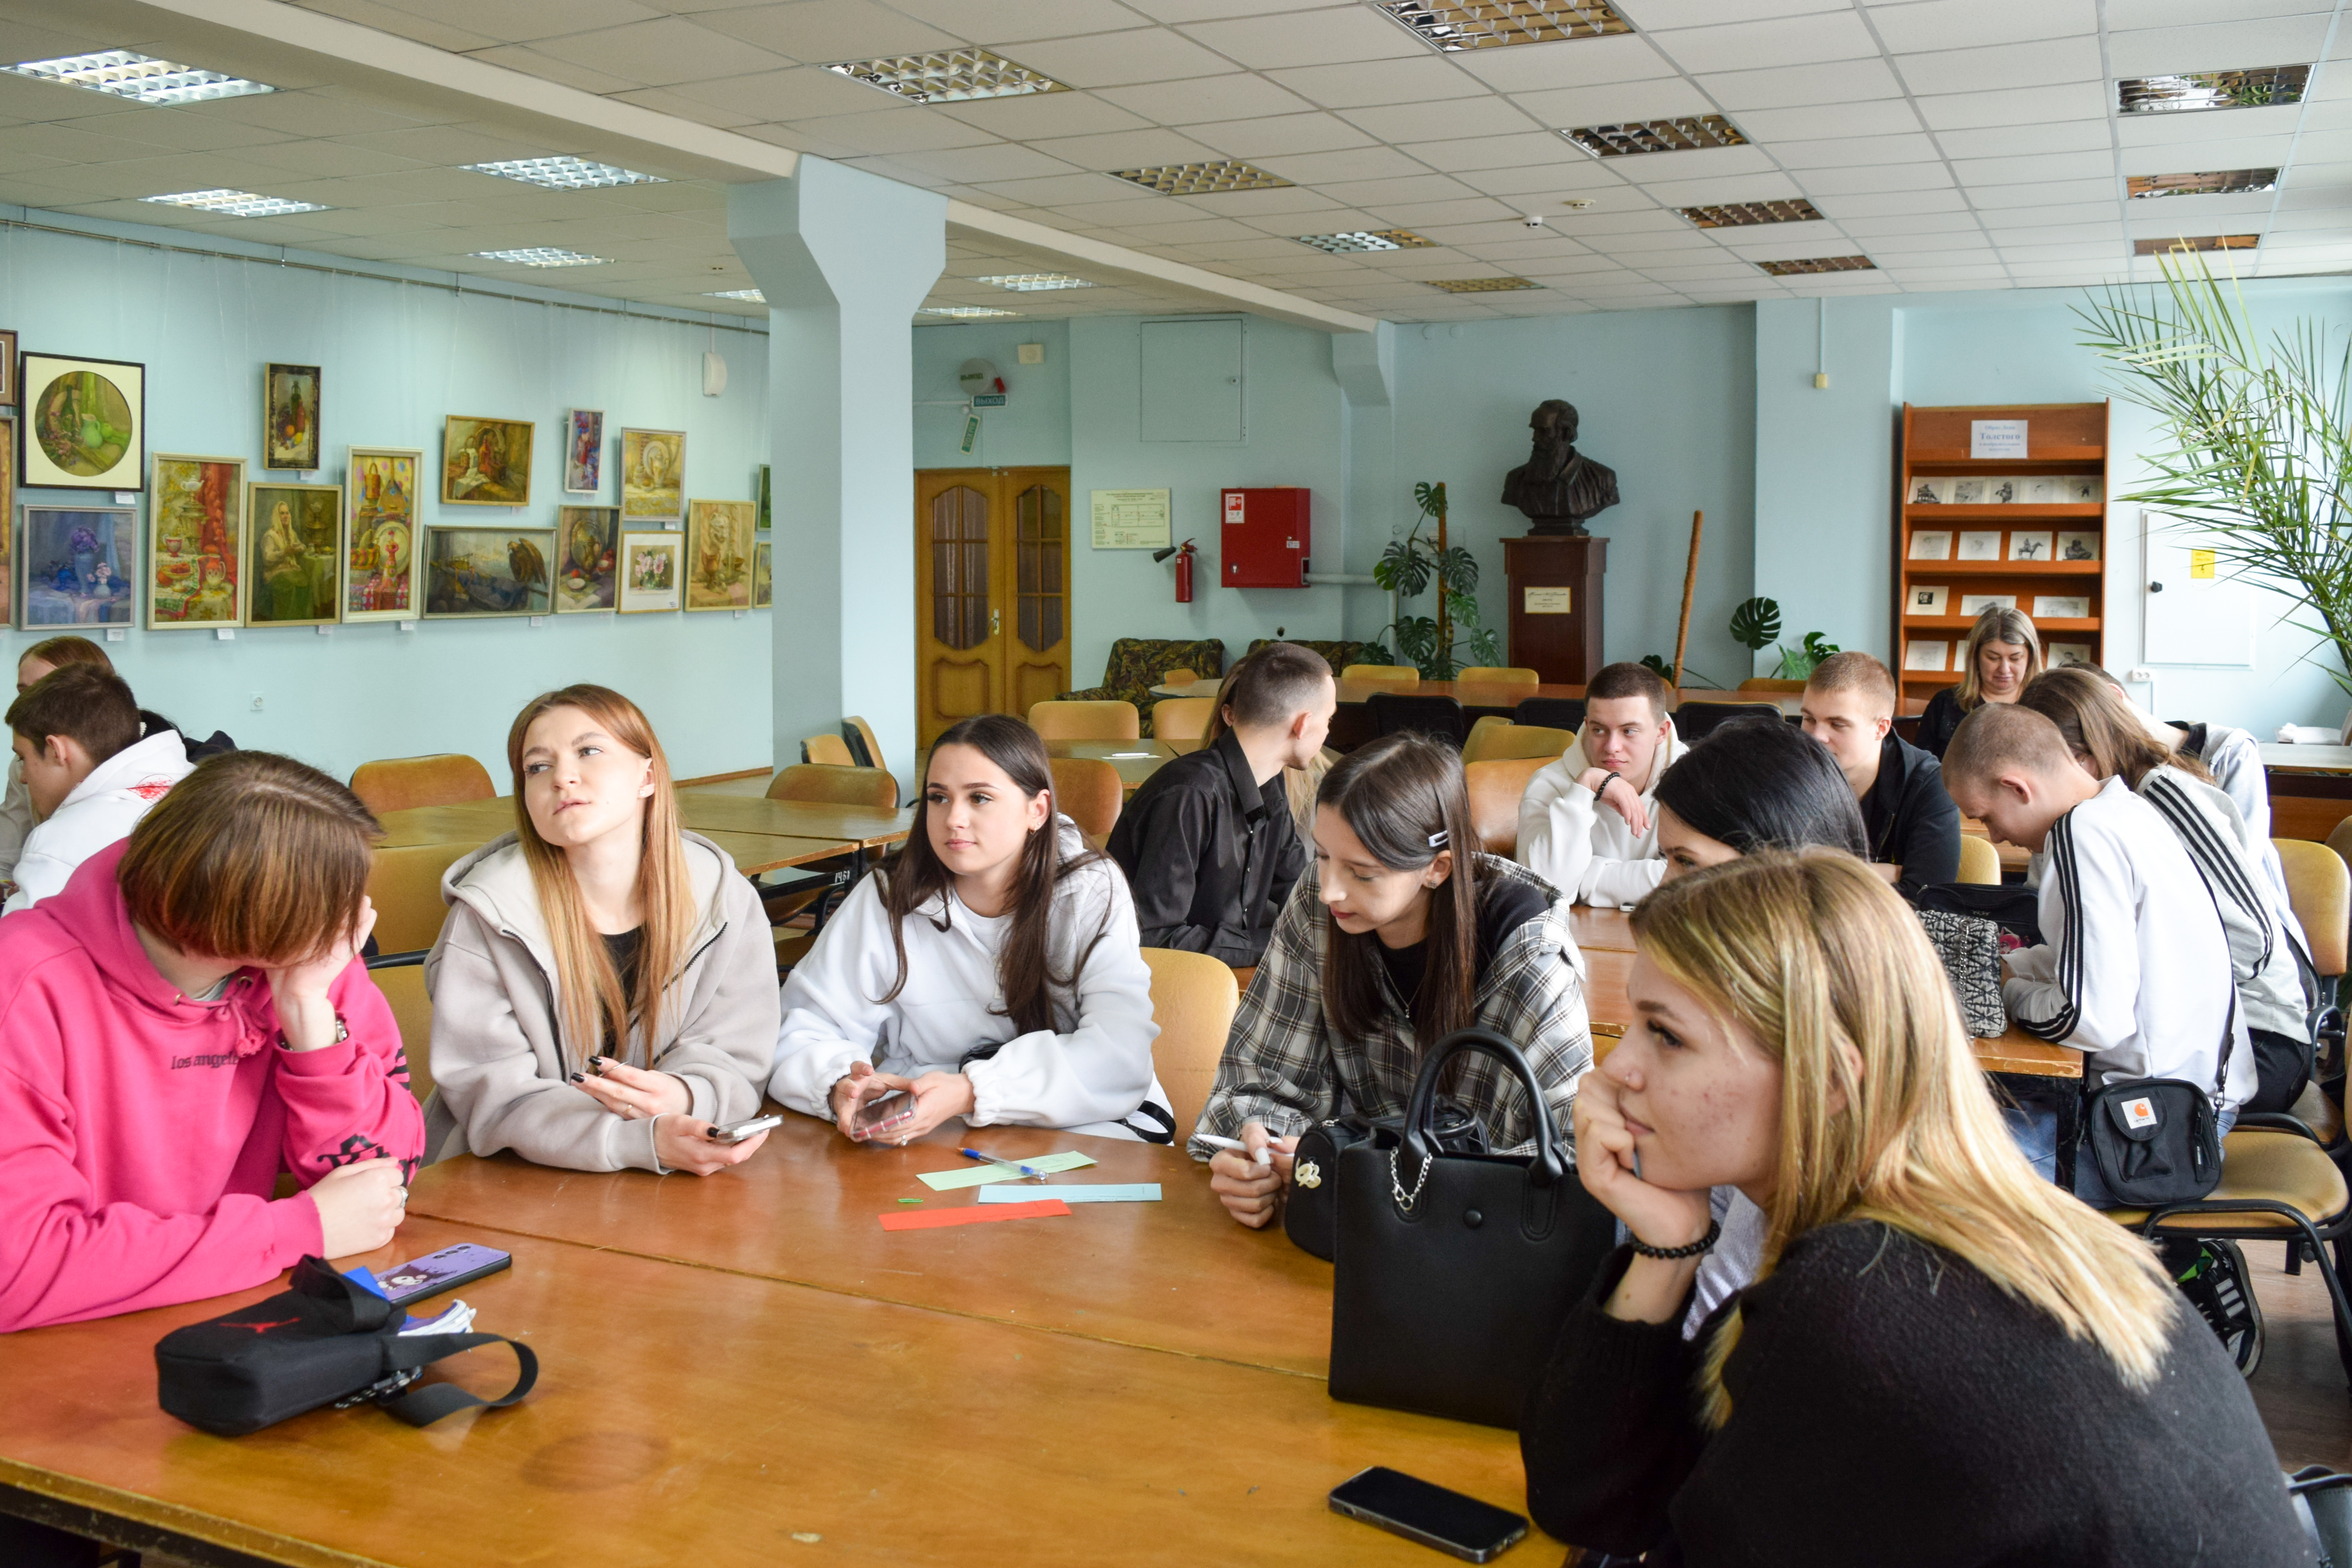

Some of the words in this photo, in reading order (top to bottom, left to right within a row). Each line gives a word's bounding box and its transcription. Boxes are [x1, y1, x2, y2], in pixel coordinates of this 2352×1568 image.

[975, 397, 1005, 405] ВЫХОД
[171, 1055, 191, 1069] los
[194, 1051, 240, 1068] angele
